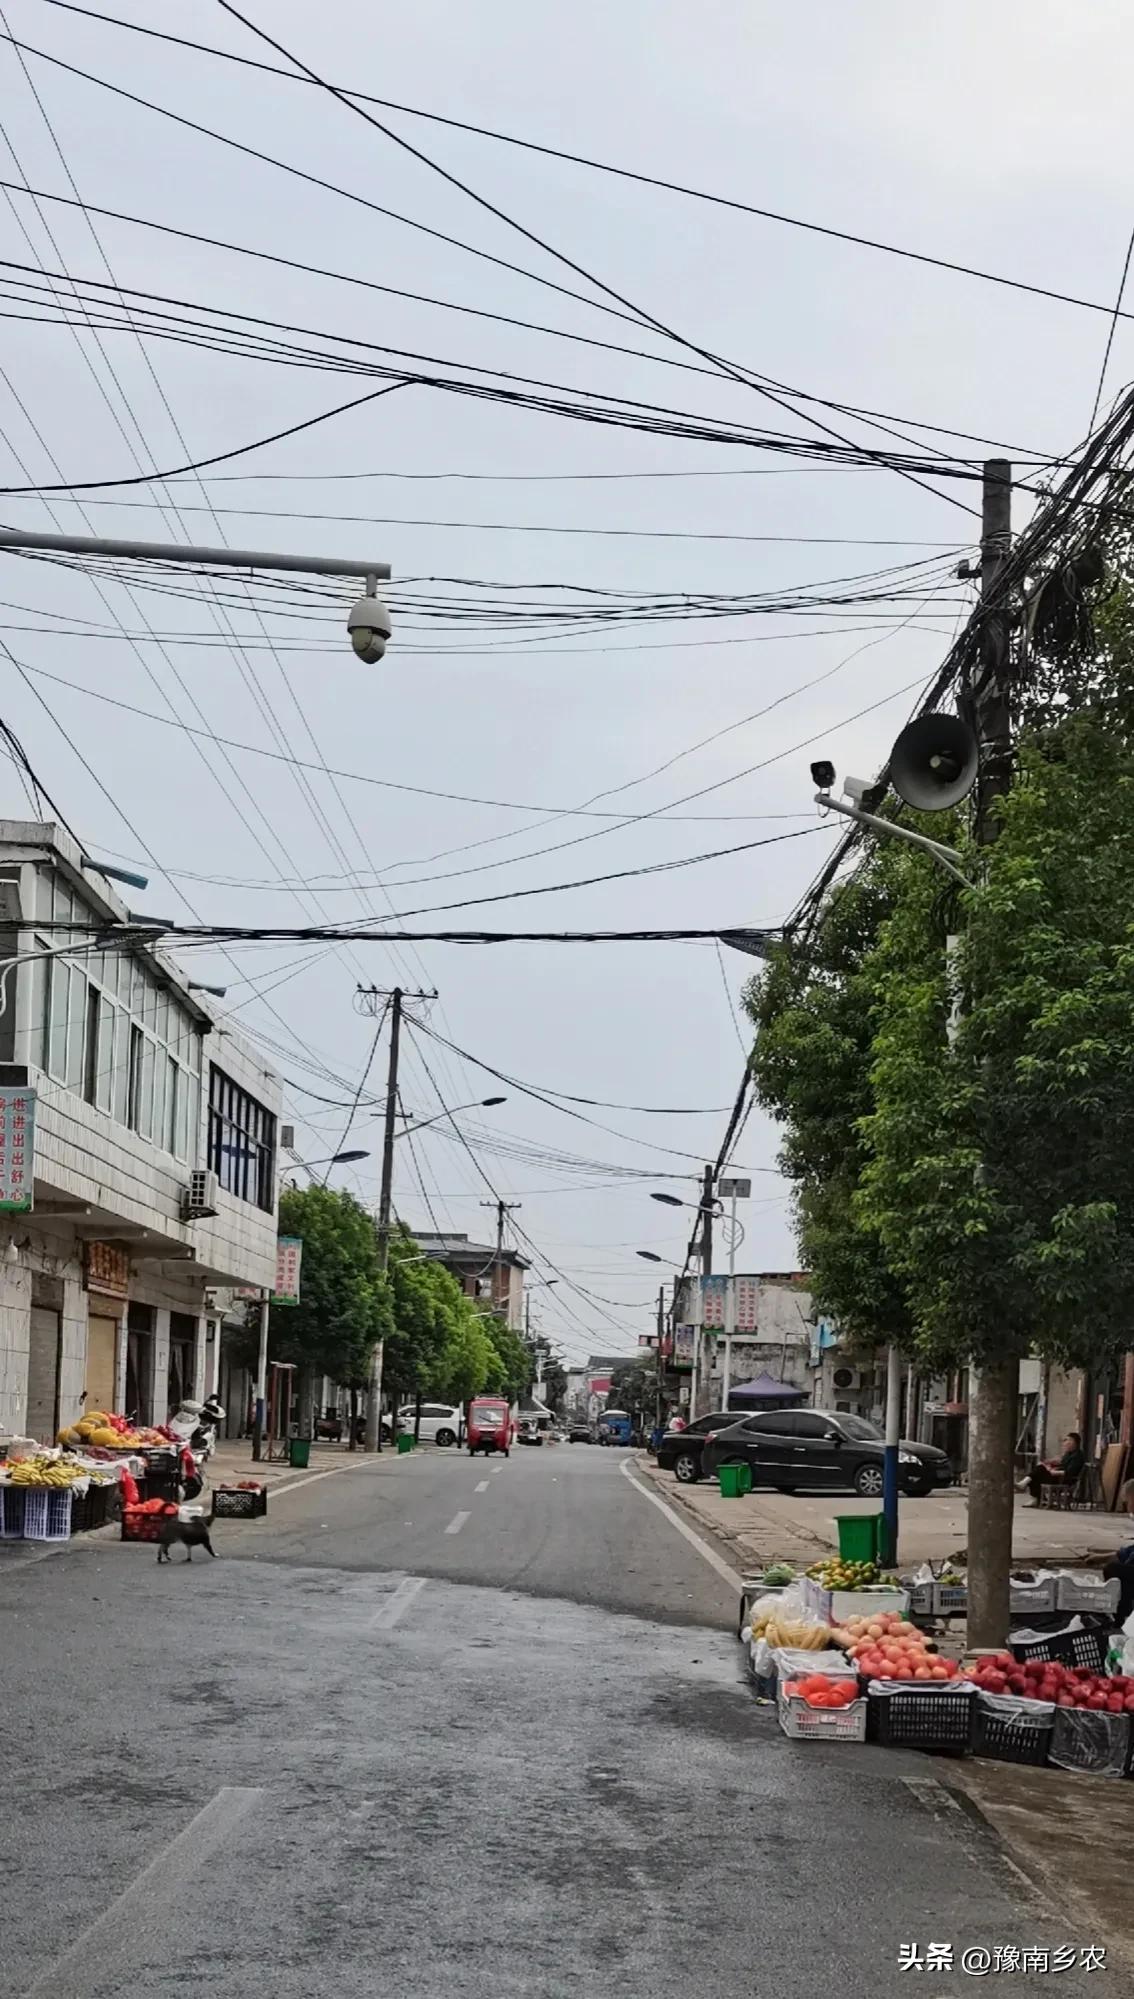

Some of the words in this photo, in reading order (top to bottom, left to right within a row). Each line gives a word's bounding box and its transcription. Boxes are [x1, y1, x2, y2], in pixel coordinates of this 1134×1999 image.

[11, 1097, 25, 1201] 进进出出舒心
